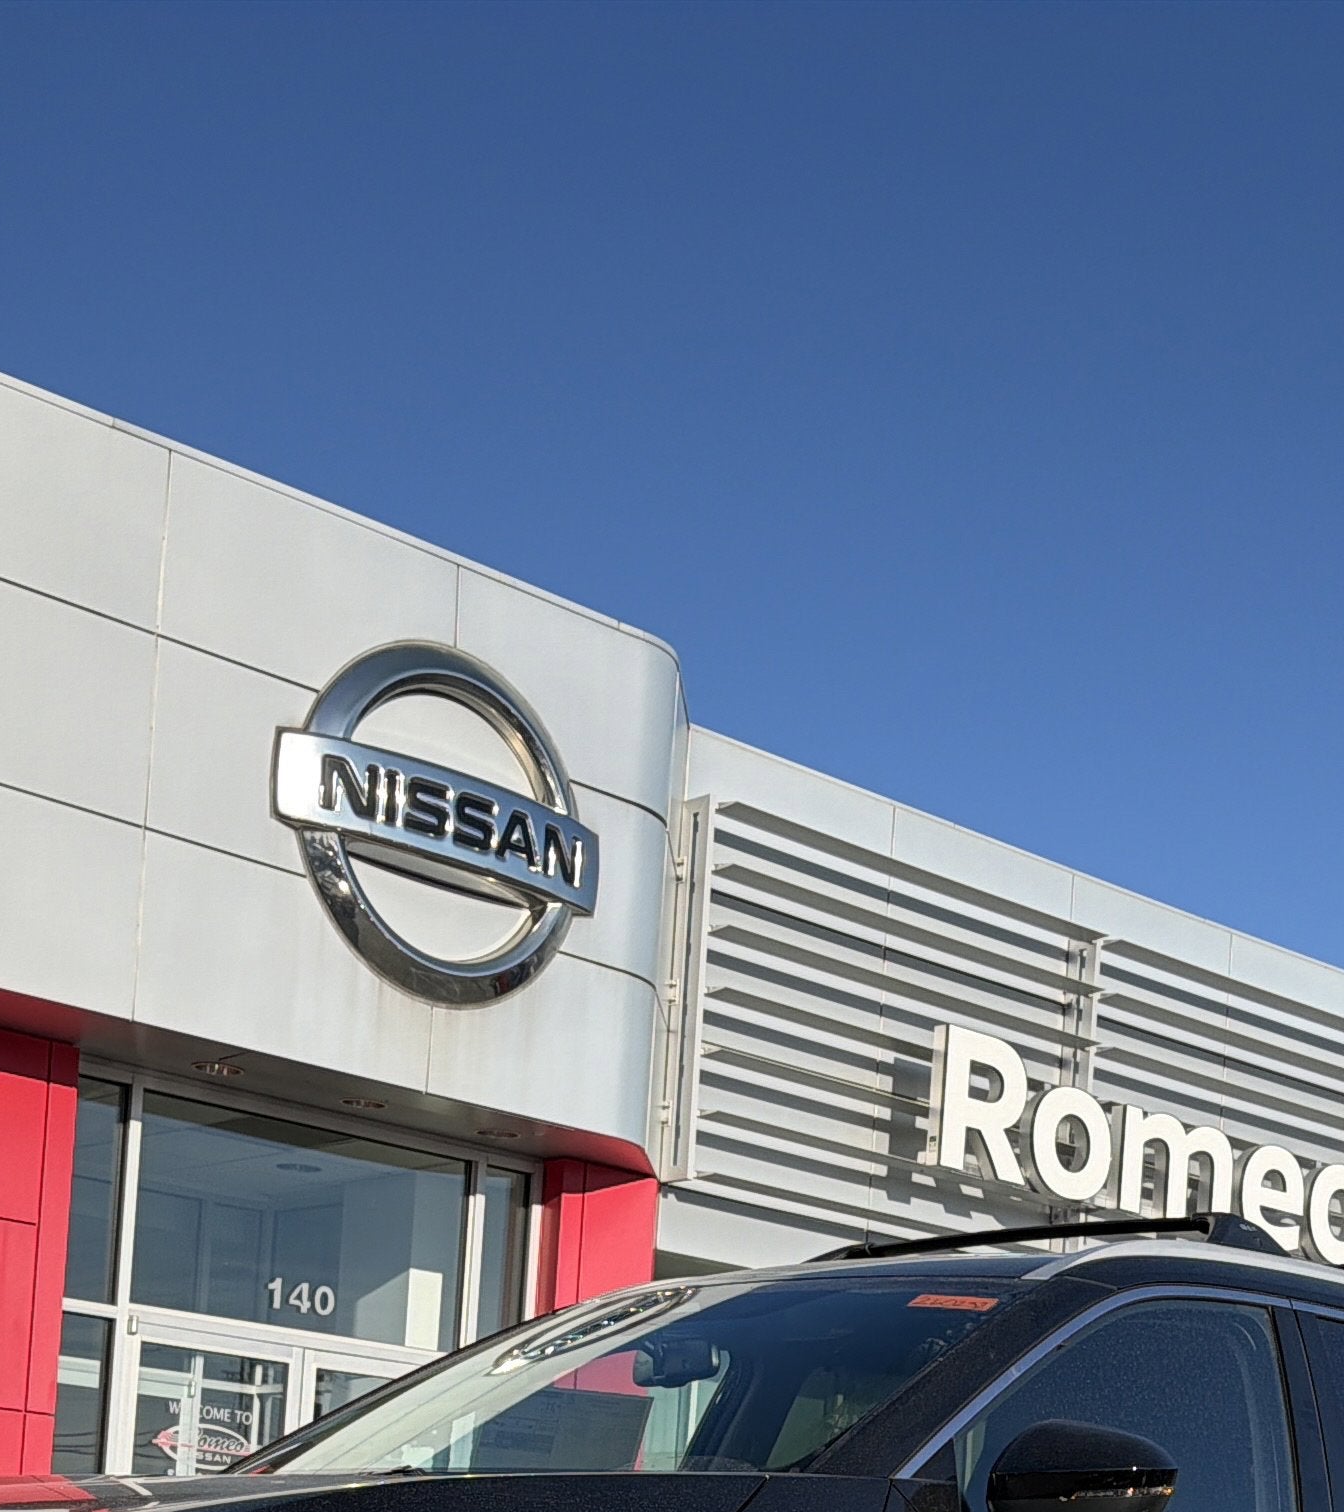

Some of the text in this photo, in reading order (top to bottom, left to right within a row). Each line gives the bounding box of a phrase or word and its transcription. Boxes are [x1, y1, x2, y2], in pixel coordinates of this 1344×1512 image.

[319, 752, 584, 890] NISSAN
[267, 1277, 335, 1316] 140
[234, 1409, 253, 1426] TO
